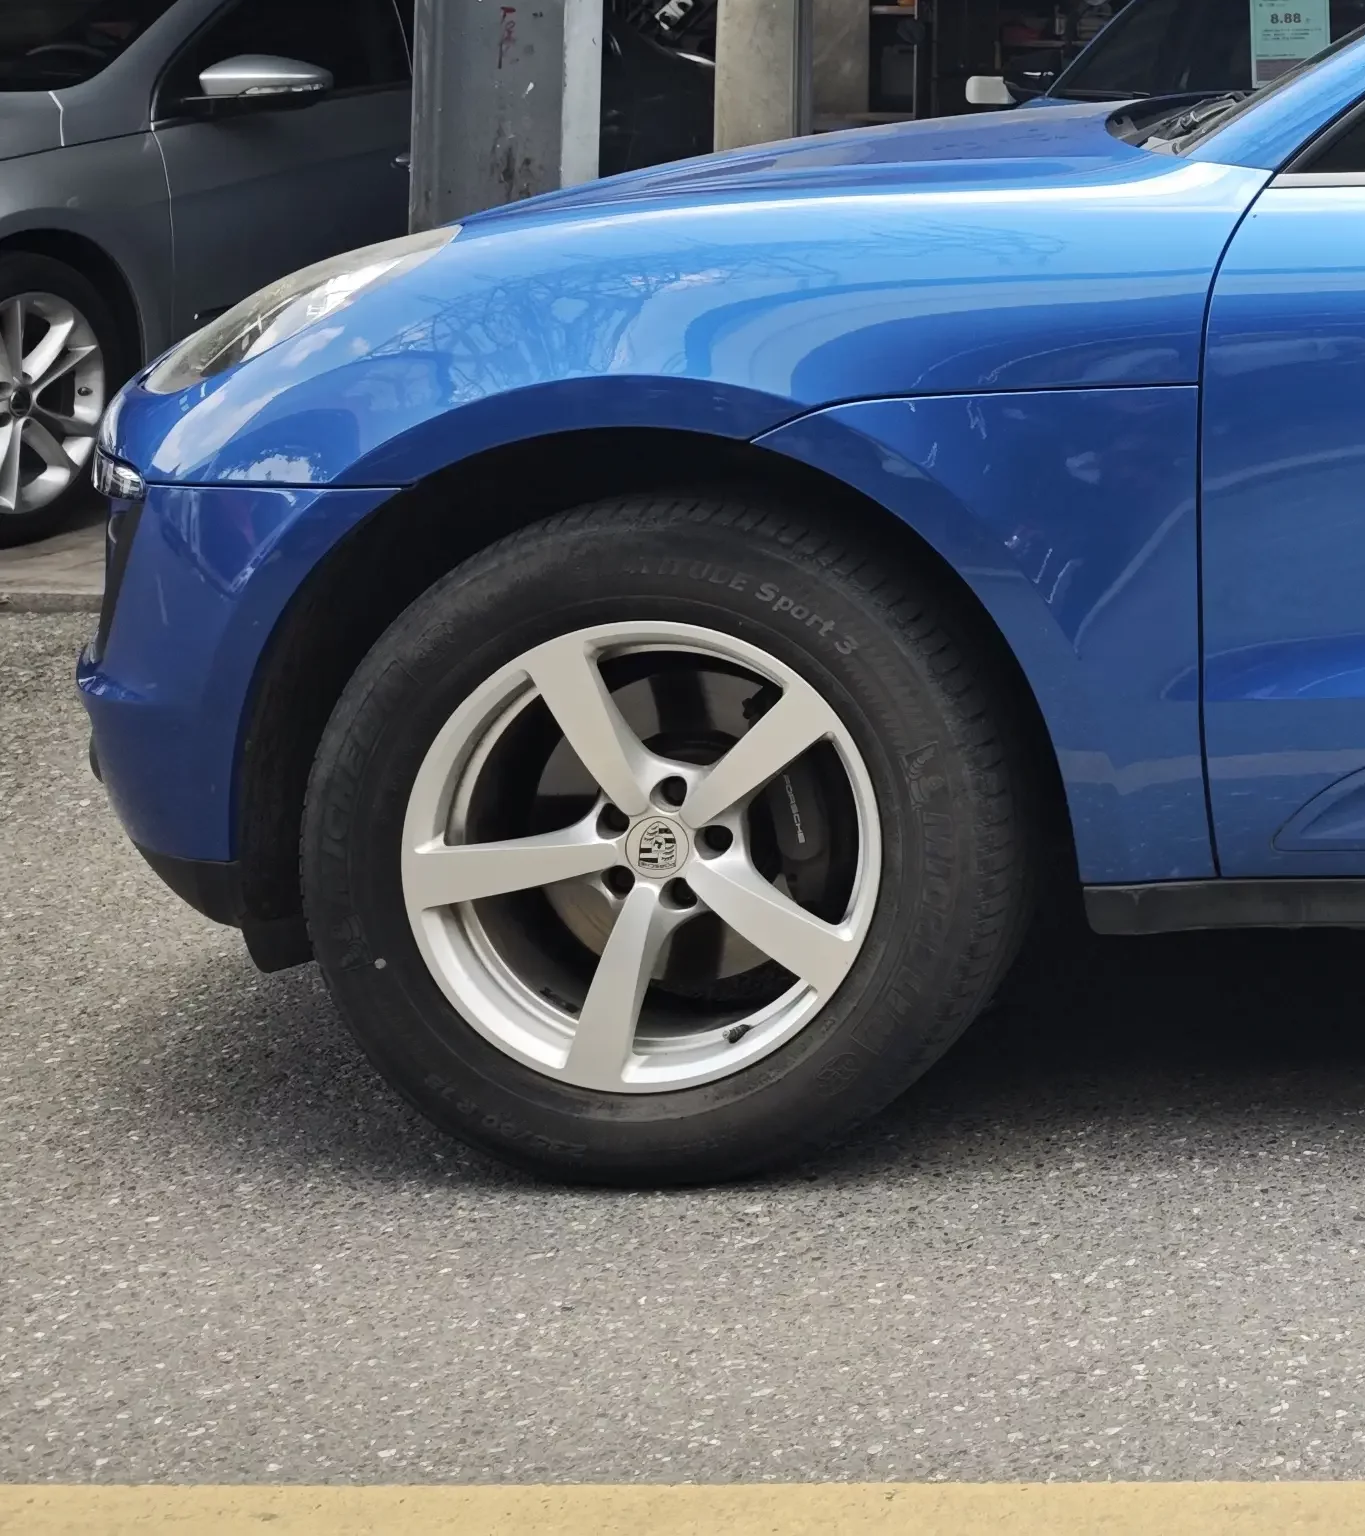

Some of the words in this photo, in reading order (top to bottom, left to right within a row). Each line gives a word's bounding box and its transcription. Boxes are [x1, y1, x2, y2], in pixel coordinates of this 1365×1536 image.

[1270, 12, 1302, 25] 8.88
[755, 581, 837, 637] Sport
[834, 629, 859, 656] 3
[780, 774, 806, 844] PORSCHE
